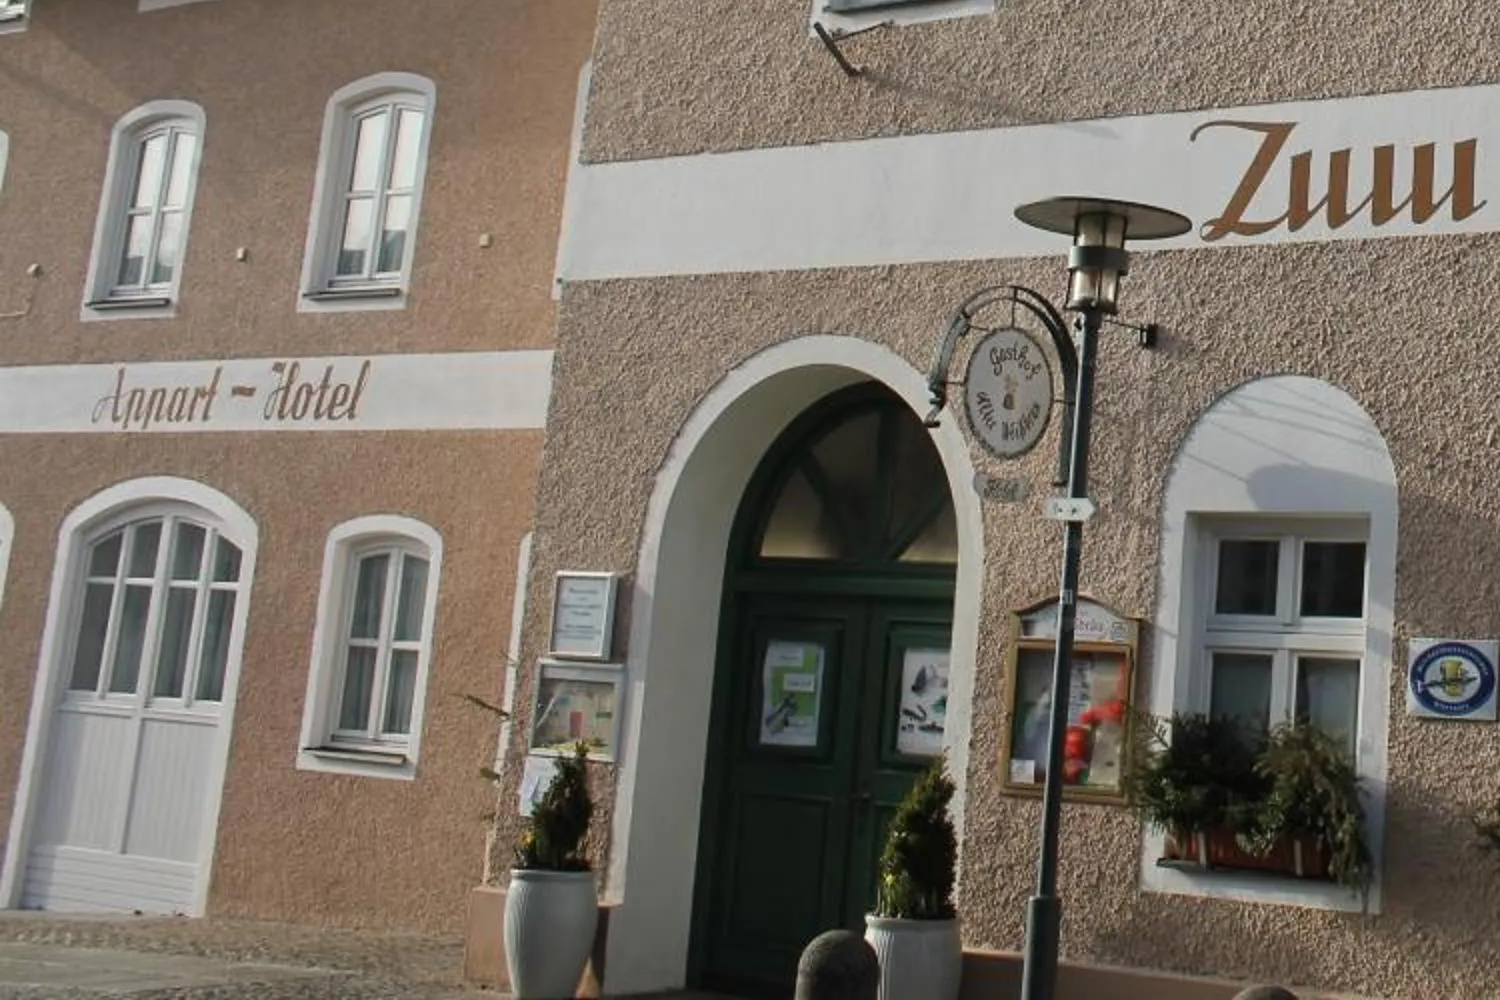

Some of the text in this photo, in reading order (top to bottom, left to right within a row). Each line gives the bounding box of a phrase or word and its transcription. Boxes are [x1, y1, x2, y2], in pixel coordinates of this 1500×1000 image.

[1189, 119, 1487, 242] Zum
[91, 366, 223, 430] Appart
[263, 359, 371, 422] Hotel
